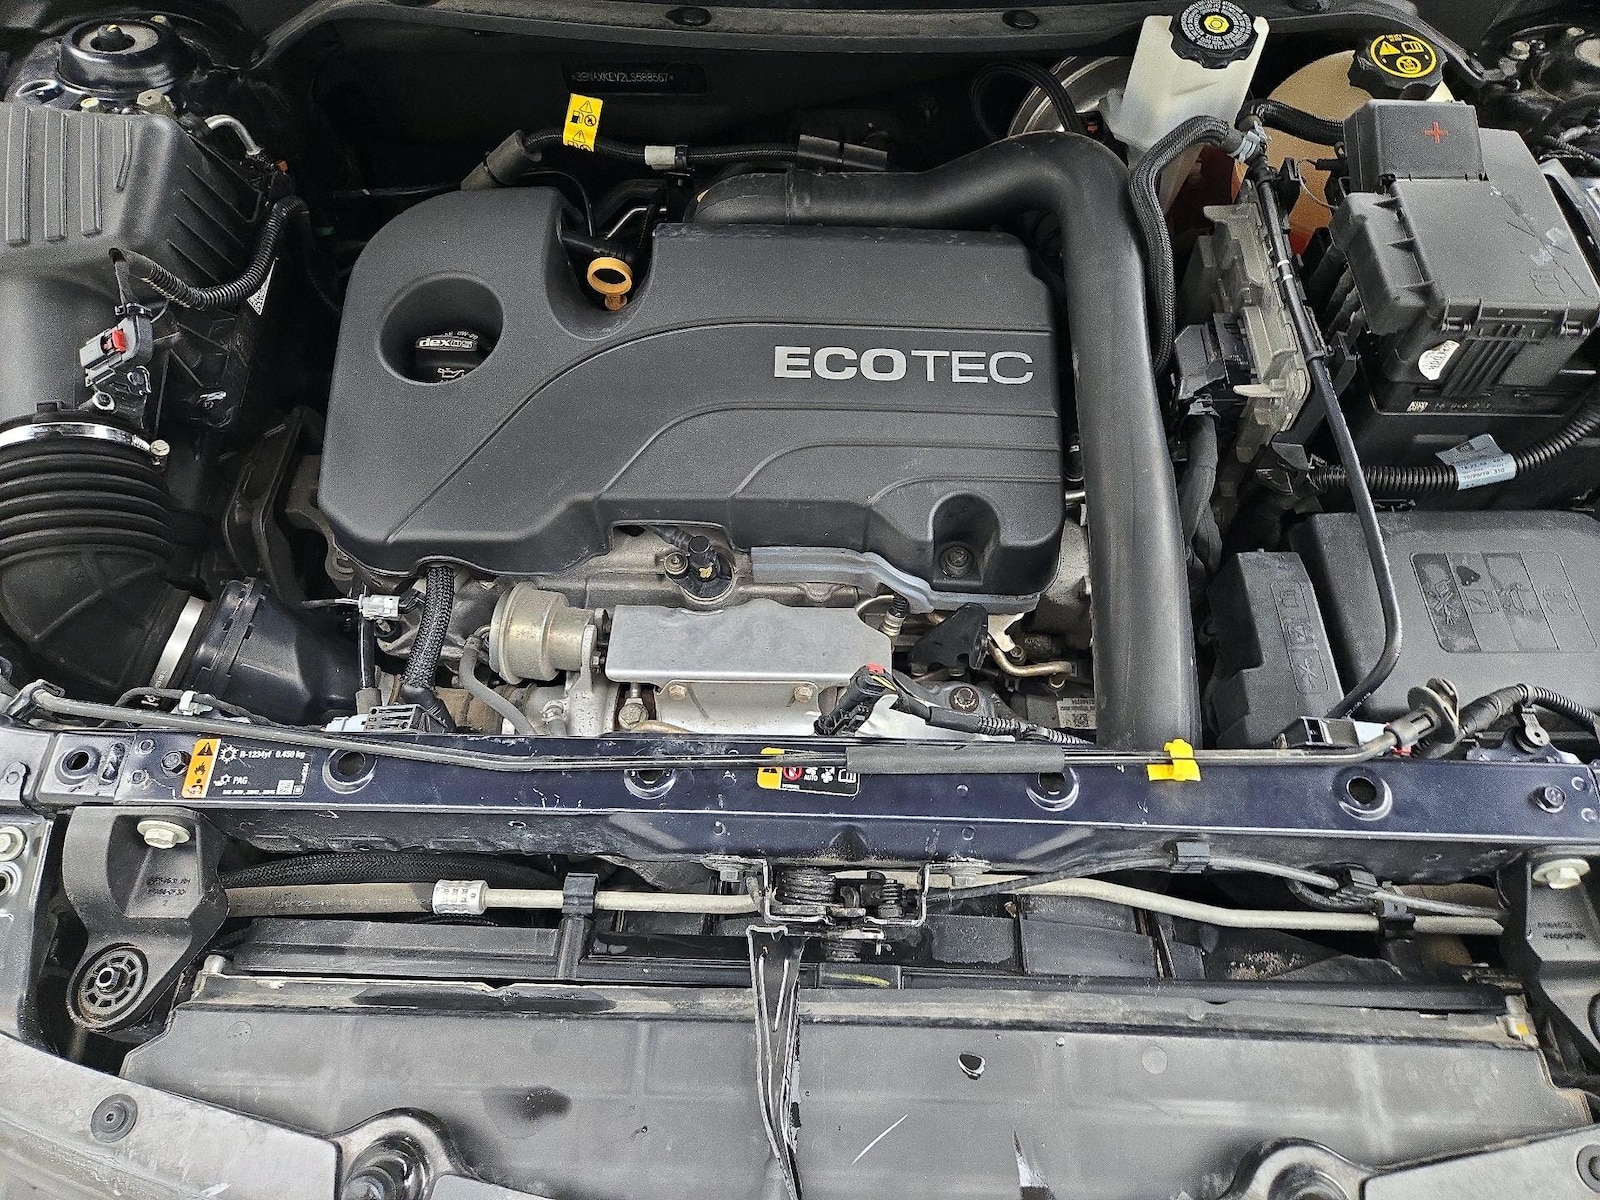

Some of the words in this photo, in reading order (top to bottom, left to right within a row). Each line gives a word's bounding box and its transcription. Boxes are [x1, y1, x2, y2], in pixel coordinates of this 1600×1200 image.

[774, 346, 1034, 385] ECOTEC
[240, 751, 272, 760] R-1234yf
[275, 751, 296, 759] 0.450
[296, 751, 306, 760] kg
[233, 777, 249, 785] PAG
